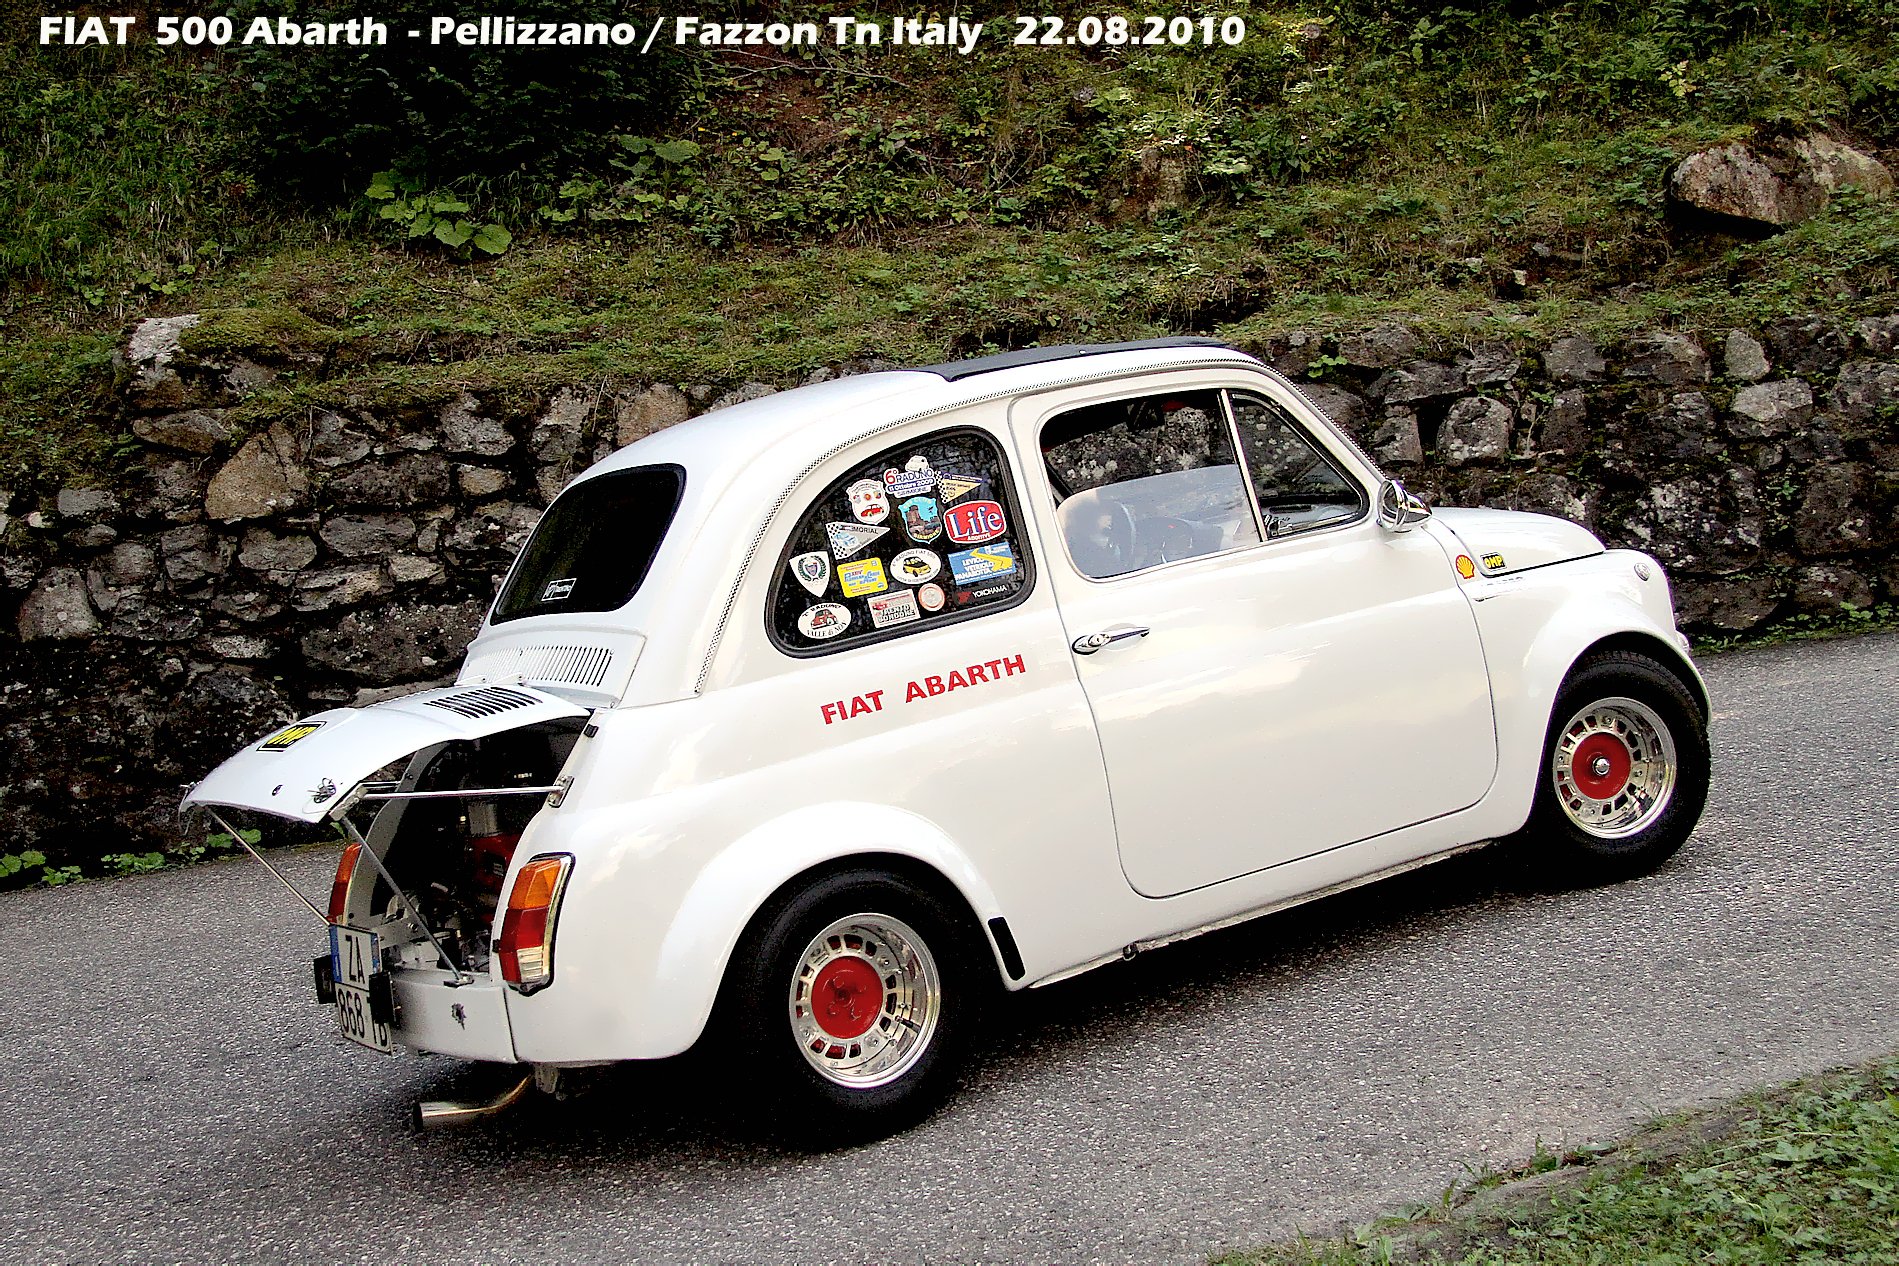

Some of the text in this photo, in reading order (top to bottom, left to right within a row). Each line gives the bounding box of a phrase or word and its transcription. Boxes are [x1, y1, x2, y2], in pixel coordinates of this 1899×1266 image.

[895, 482, 917, 490] Ottobre
[917, 478, 934, 487] 2009
[896, 468, 933, 483] RADUNO
[946, 506, 1003, 539] Life
[1484, 554, 1504, 569] OMP
[972, 584, 1008, 598] YOKOHAMA
[820, 654, 1026, 725] FIAT ABARTH
[345, 934, 366, 985] ZA
[337, 987, 366, 1039] 868
